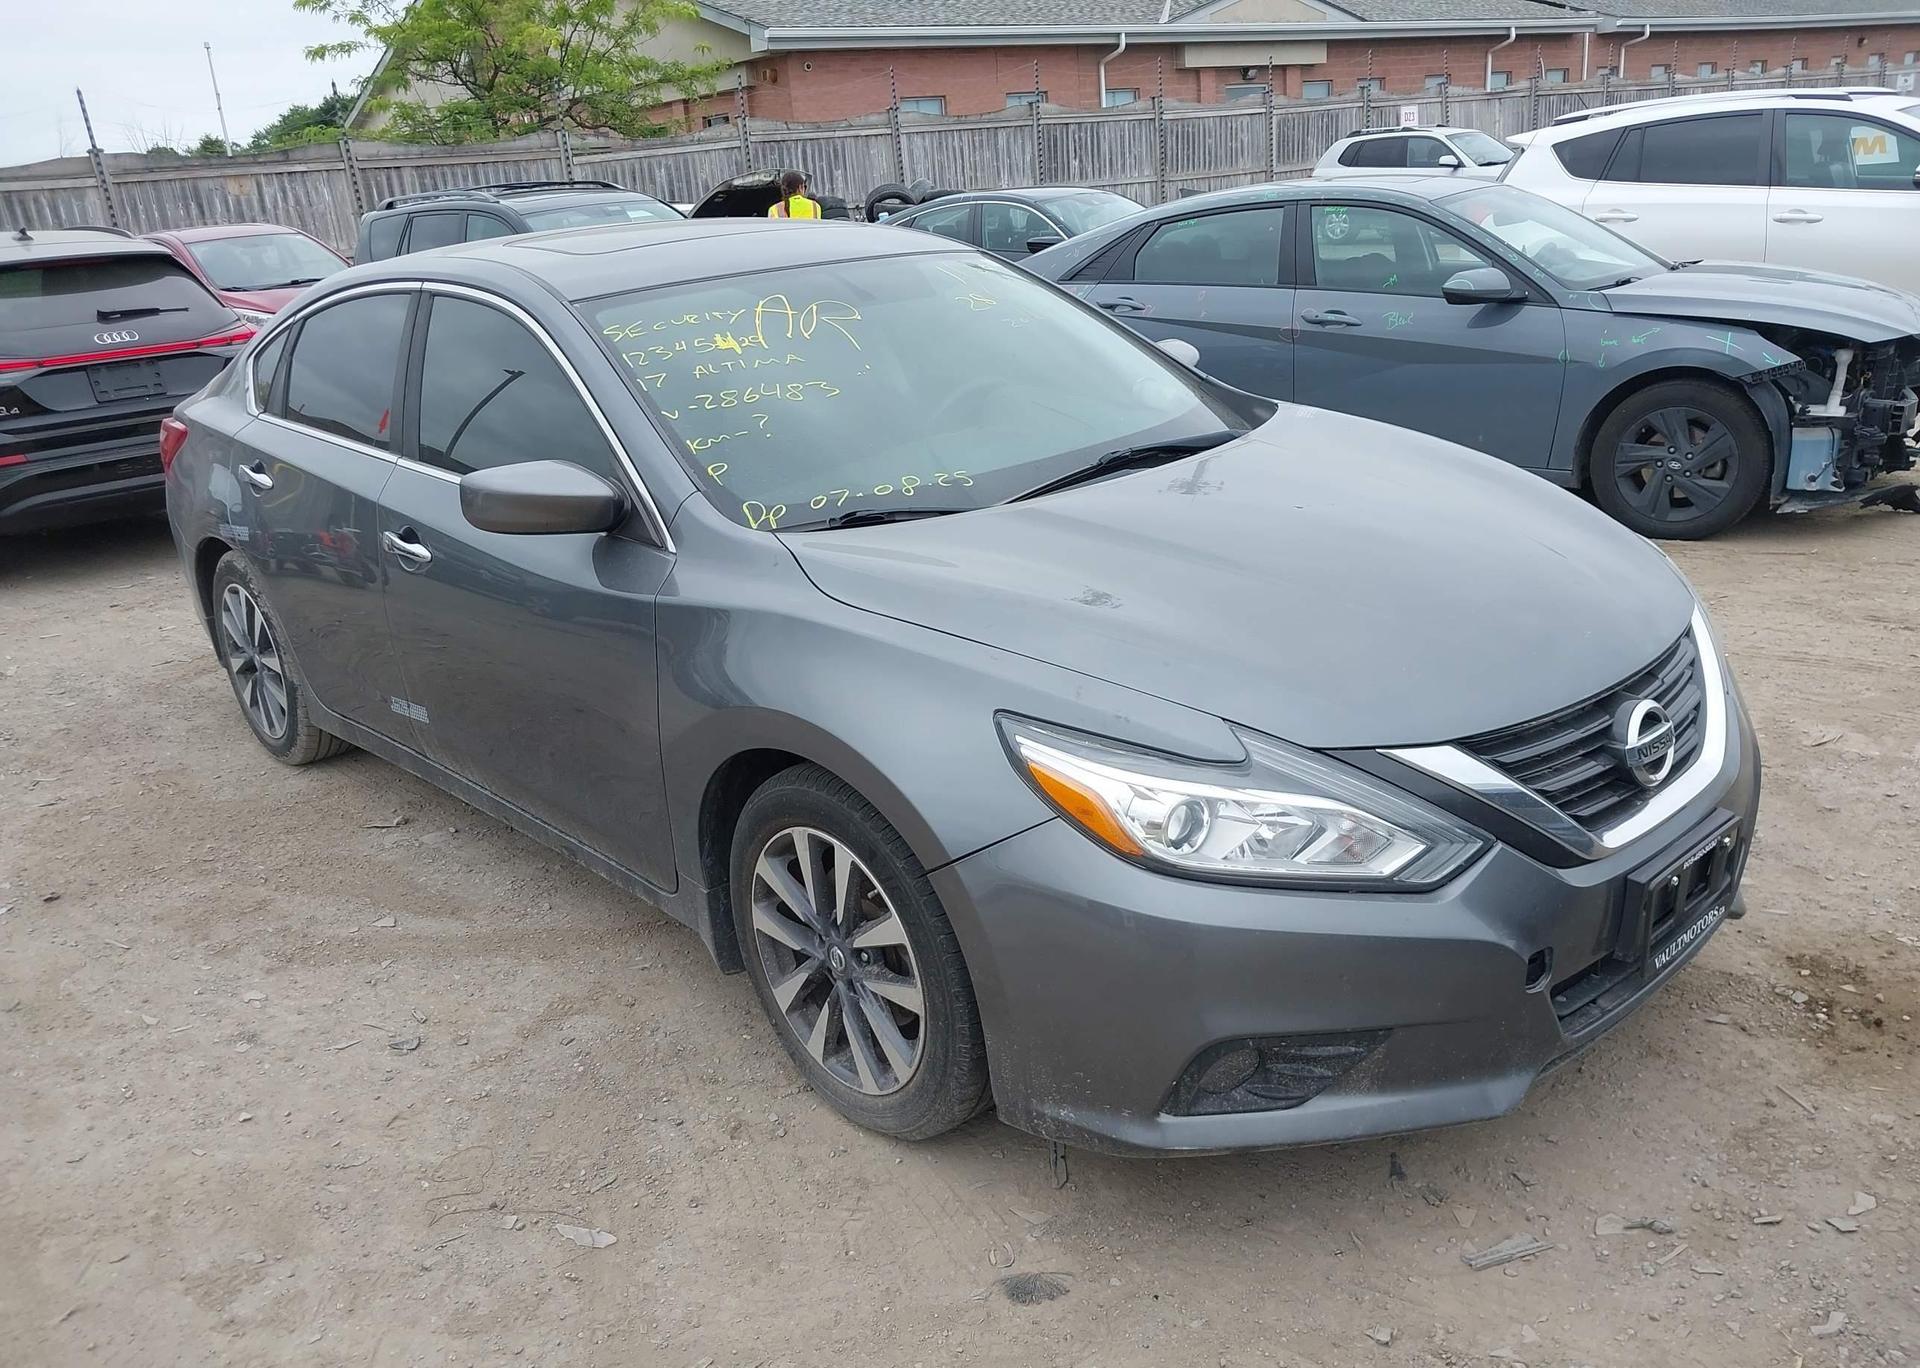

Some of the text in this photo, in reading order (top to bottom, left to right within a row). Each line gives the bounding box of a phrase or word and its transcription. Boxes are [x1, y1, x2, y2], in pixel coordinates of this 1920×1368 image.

[603, 308, 746, 342] SECURITY
[636, 353, 806, 391] 17 ALTIMA
